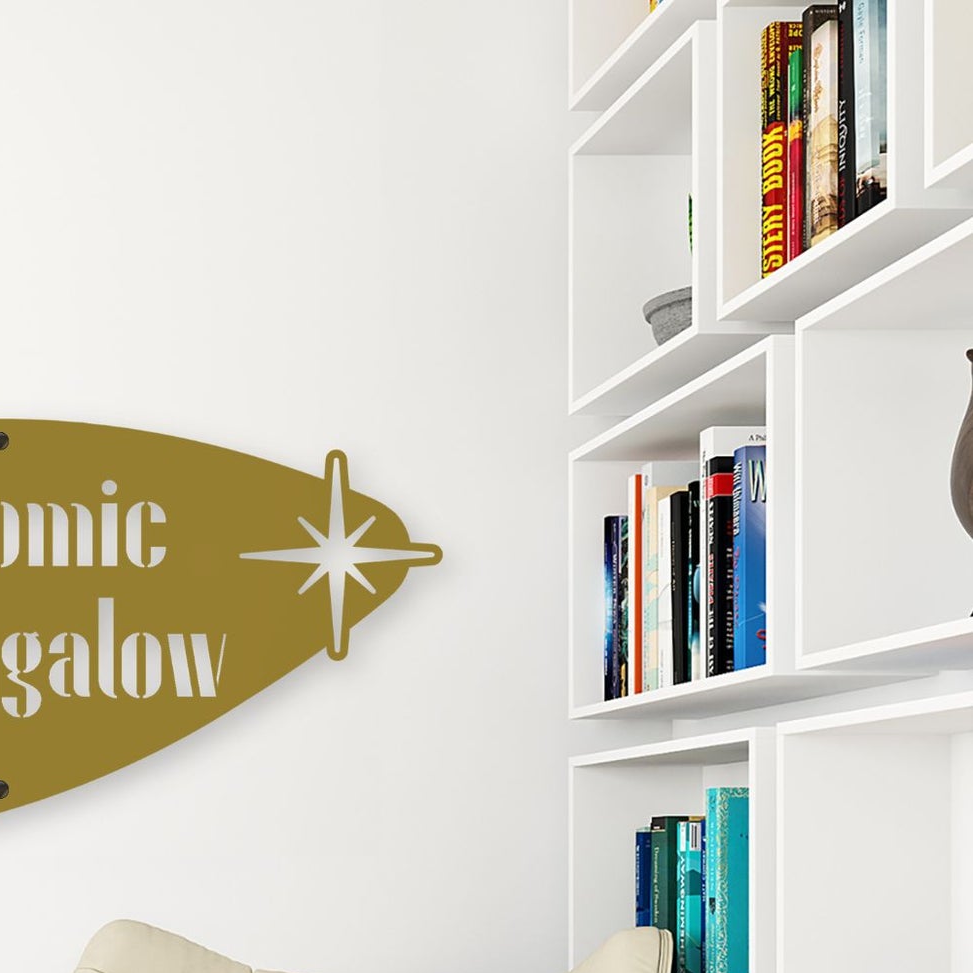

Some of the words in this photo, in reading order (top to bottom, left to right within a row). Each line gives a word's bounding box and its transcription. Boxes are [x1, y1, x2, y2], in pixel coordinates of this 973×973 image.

[762, 125, 783, 194] BOOK
[839, 100, 848, 171] INIQUITY
[762, 203, 783, 277] STERY
